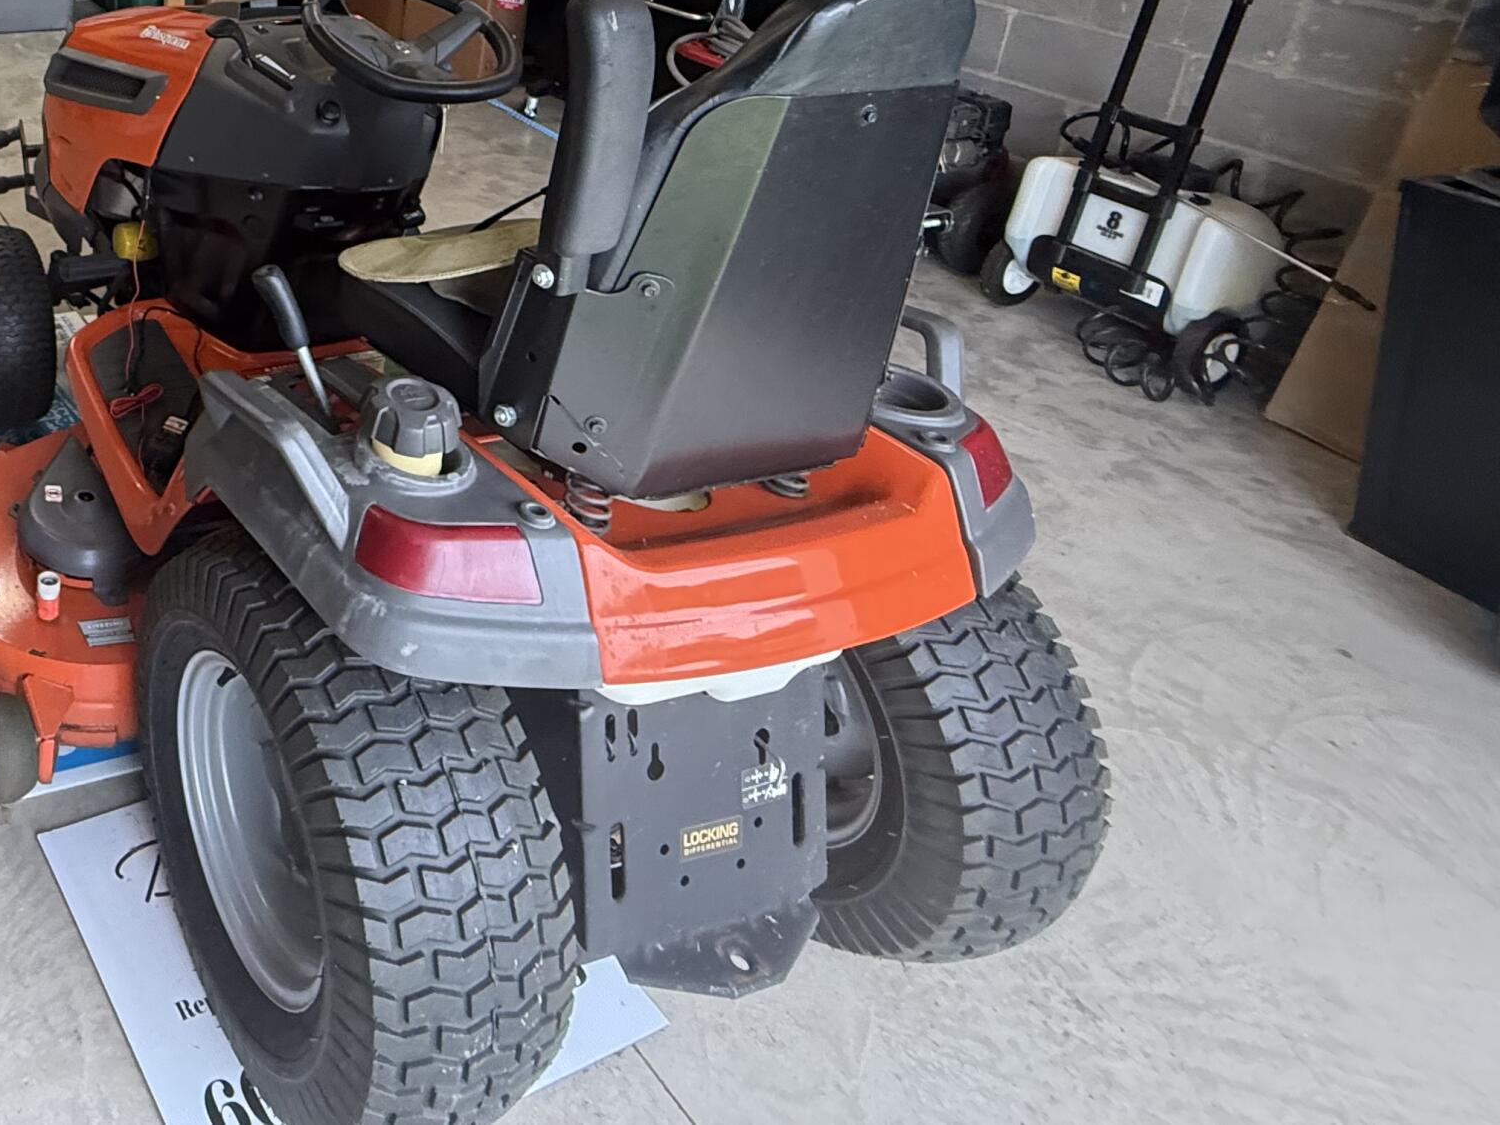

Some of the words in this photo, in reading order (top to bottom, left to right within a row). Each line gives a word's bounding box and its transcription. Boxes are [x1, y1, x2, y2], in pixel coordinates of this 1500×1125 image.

[1106, 211, 1122, 230] 8
[683, 821, 739, 847] LOCKING
[683, 837, 738, 856] DIFFERENTIAL
